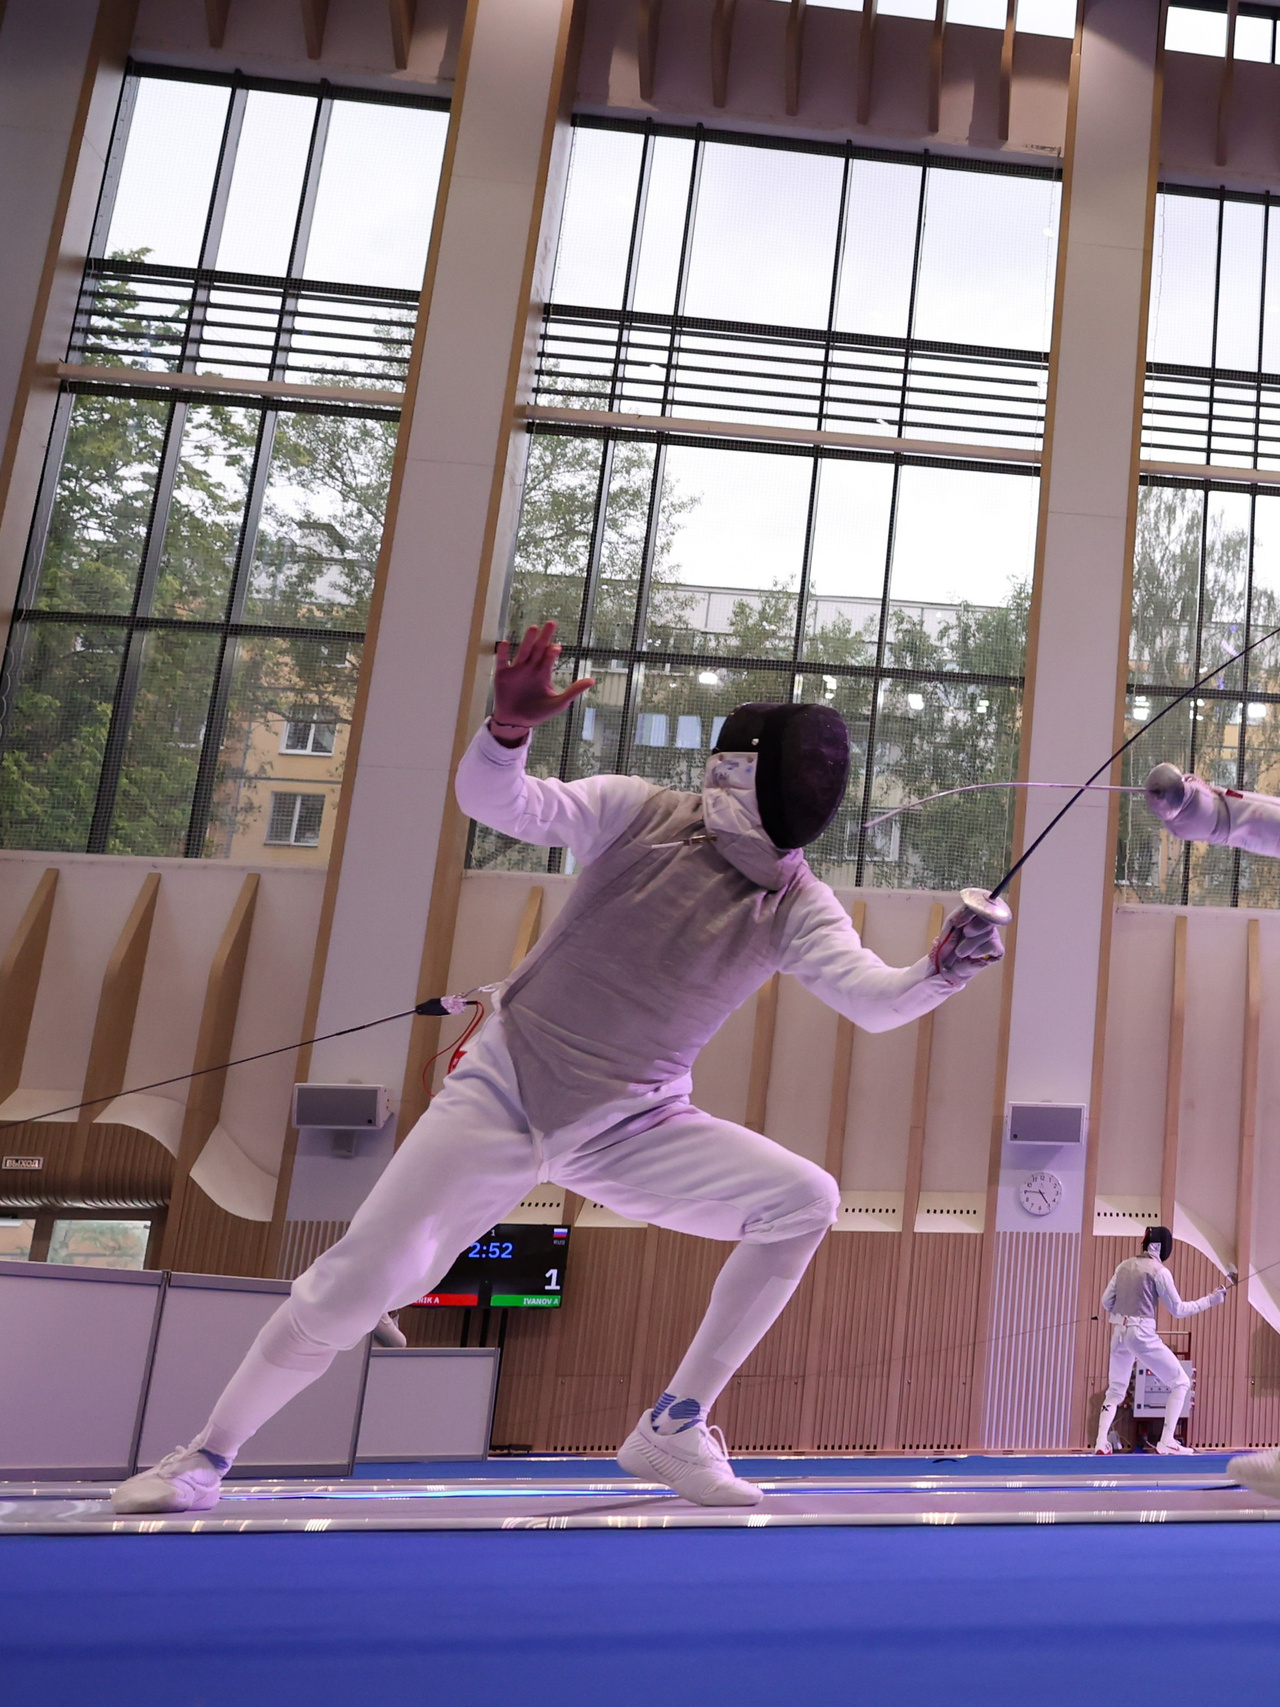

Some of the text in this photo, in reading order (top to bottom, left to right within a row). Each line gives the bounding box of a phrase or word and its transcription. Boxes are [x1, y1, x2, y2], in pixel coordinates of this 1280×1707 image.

[468, 1242, 513, 1258] 2:52
[544, 1268, 561, 1290] 1
[523, 1297, 552, 1305] IVANOV
